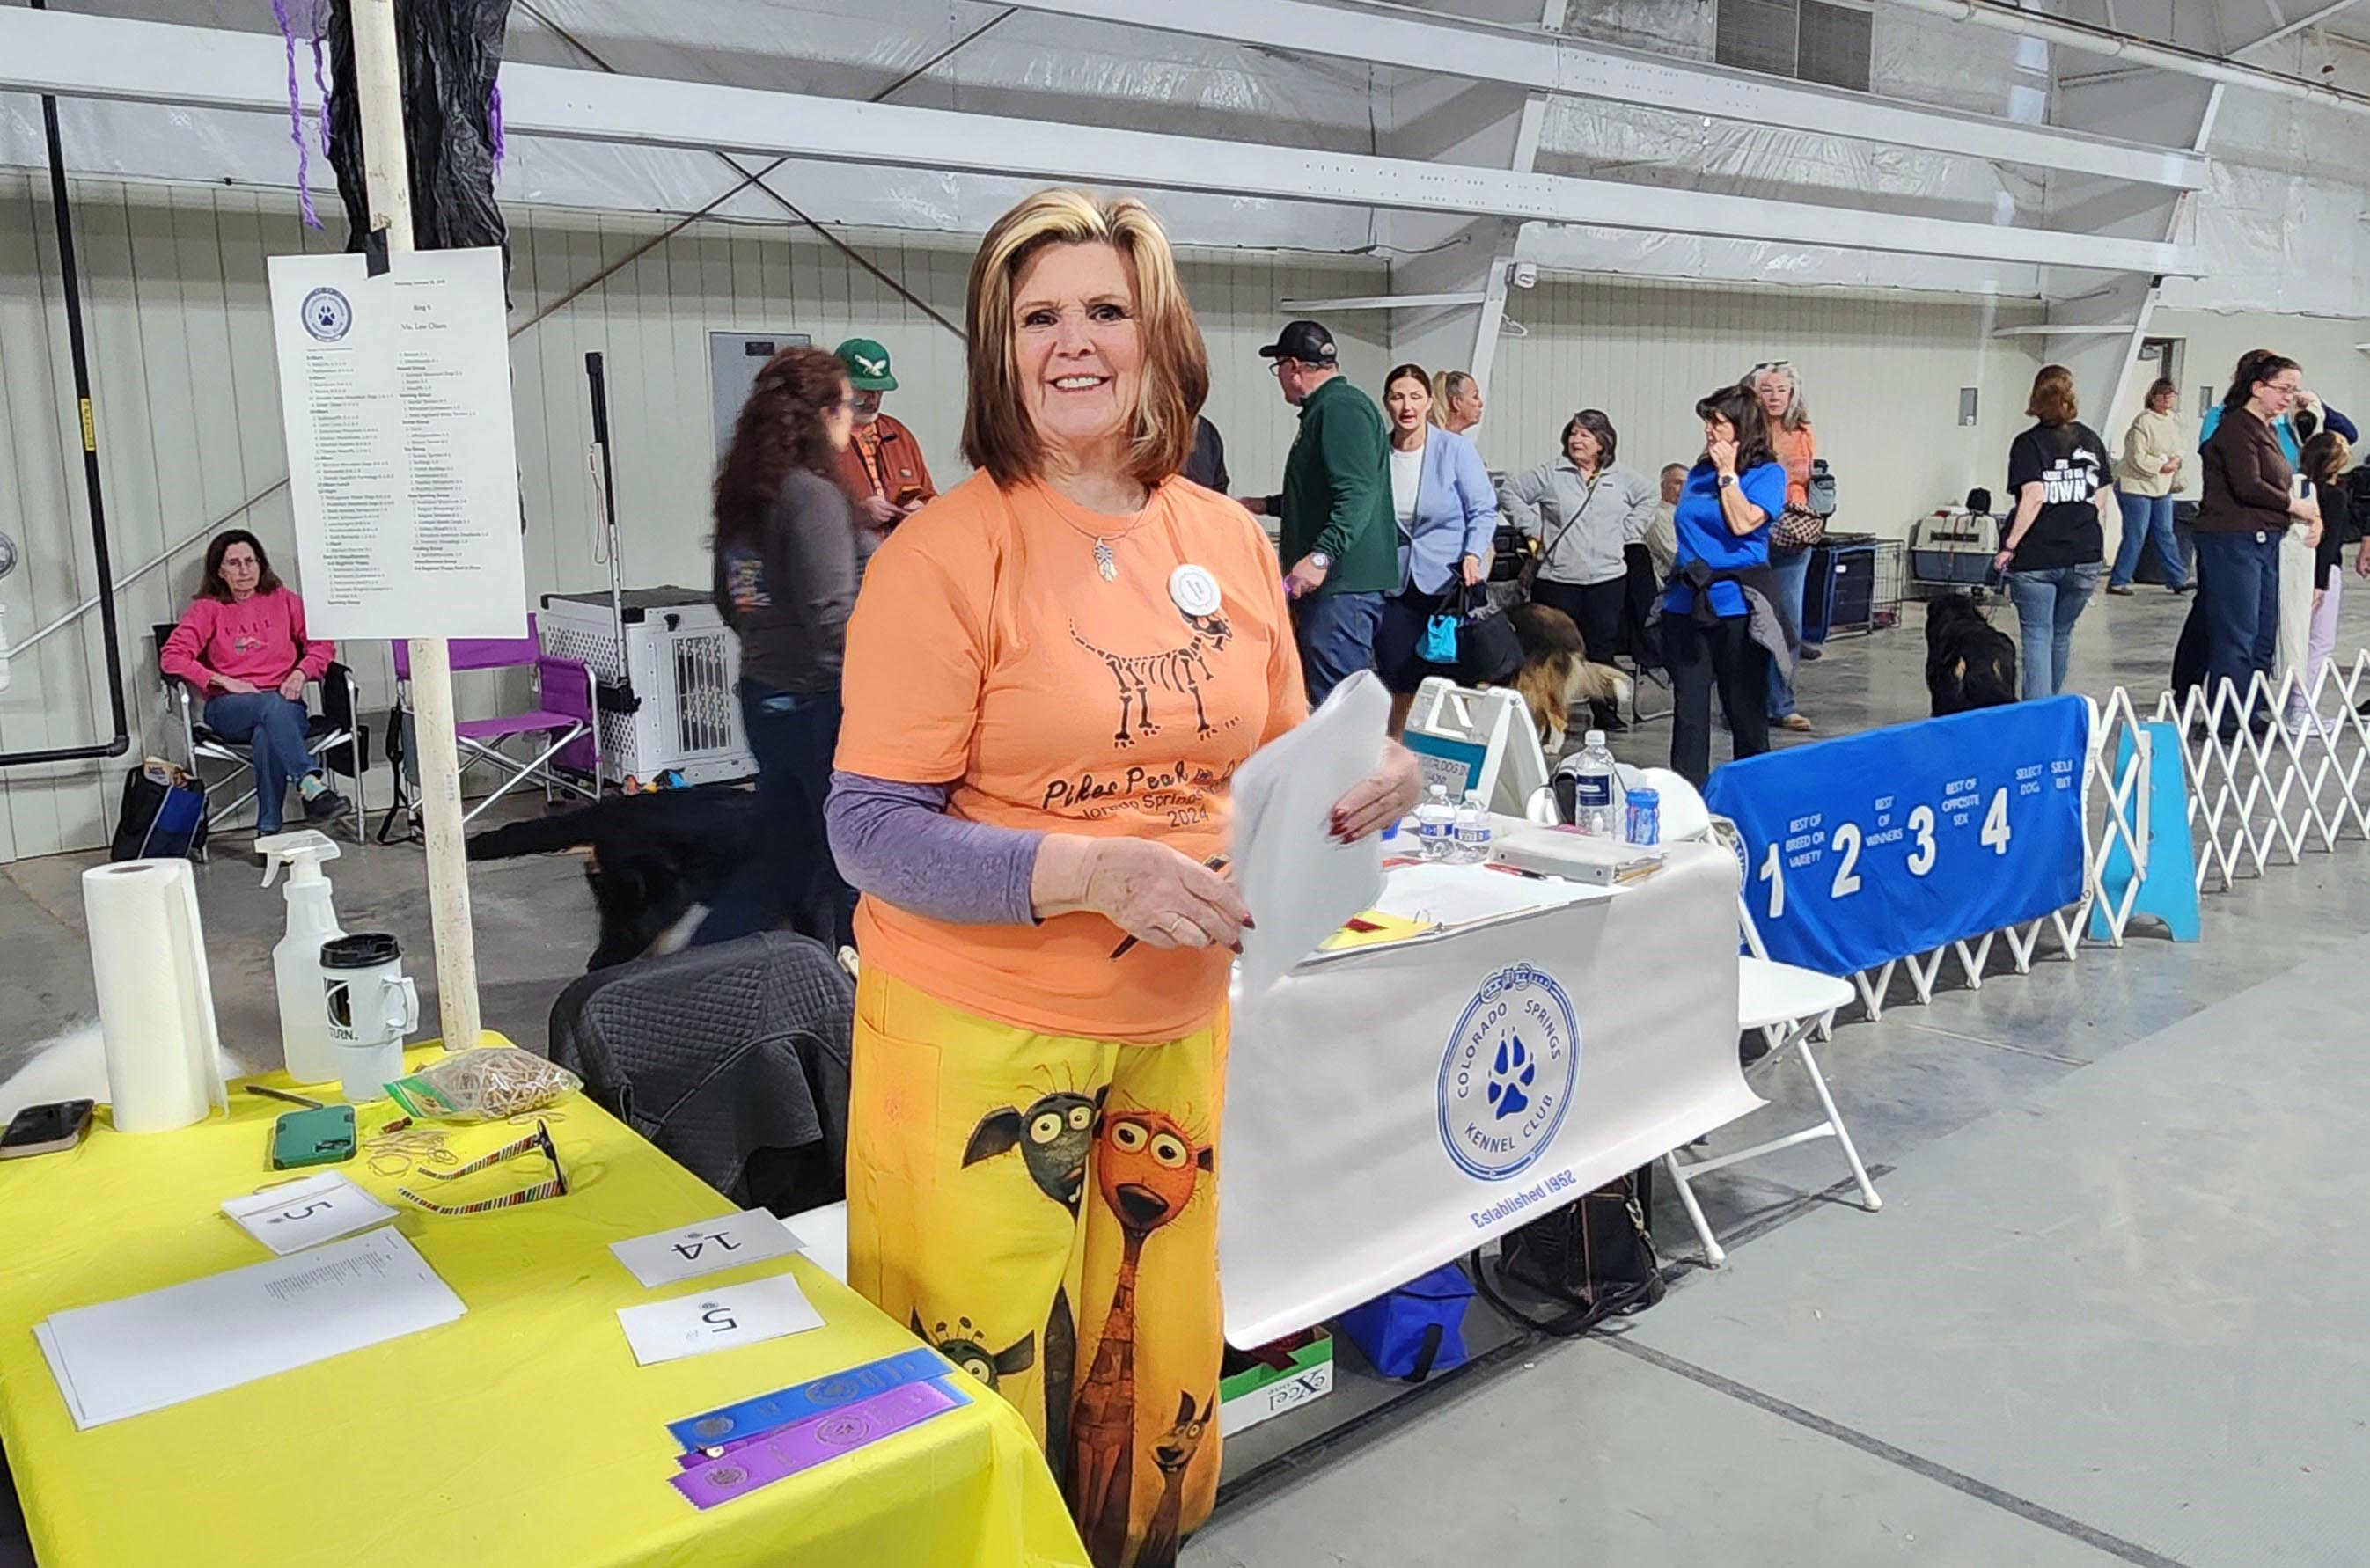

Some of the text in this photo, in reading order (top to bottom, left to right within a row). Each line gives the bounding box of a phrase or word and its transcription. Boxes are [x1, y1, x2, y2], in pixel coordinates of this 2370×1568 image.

[2015, 764, 2043, 780] SELECT
[1042, 774, 1118, 810] Pikes
[1125, 760, 1189, 794] Peak
[1945, 778, 1977, 795] BEST OF
[2020, 780, 2040, 795] DOG
[1875, 795, 1894, 811] BEST
[1941, 794, 1980, 812] OPPOSITE
[1168, 805, 1209, 829] 2024
[1790, 813, 1822, 833] BEST OF
[1878, 814, 1890, 828] OF
[1953, 813, 1969, 826] SEX
[1981, 787, 2011, 854] 4
[1785, 832, 1825, 852] BREED OR
[1866, 828, 1903, 846] WINNERS
[1907, 805, 1936, 876] 3
[1788, 850, 1823, 868] VARIETY
[1831, 823, 1861, 898] 2
[1760, 842, 1784, 918] 1
[329, 1026, 354, 1040] TURN
[1524, 999, 1561, 1060] SPRINGS
[1457, 1002, 1508, 1099] COLORADO
[1523, 1095, 1553, 1139] CLUB
[1464, 1122, 1516, 1153] KENNEL
[283, 1200, 334, 1220] 5
[1470, 1169, 1577, 1230] Established 1952
[671, 1231, 741, 1260] 14
[701, 1307, 737, 1333] 5
